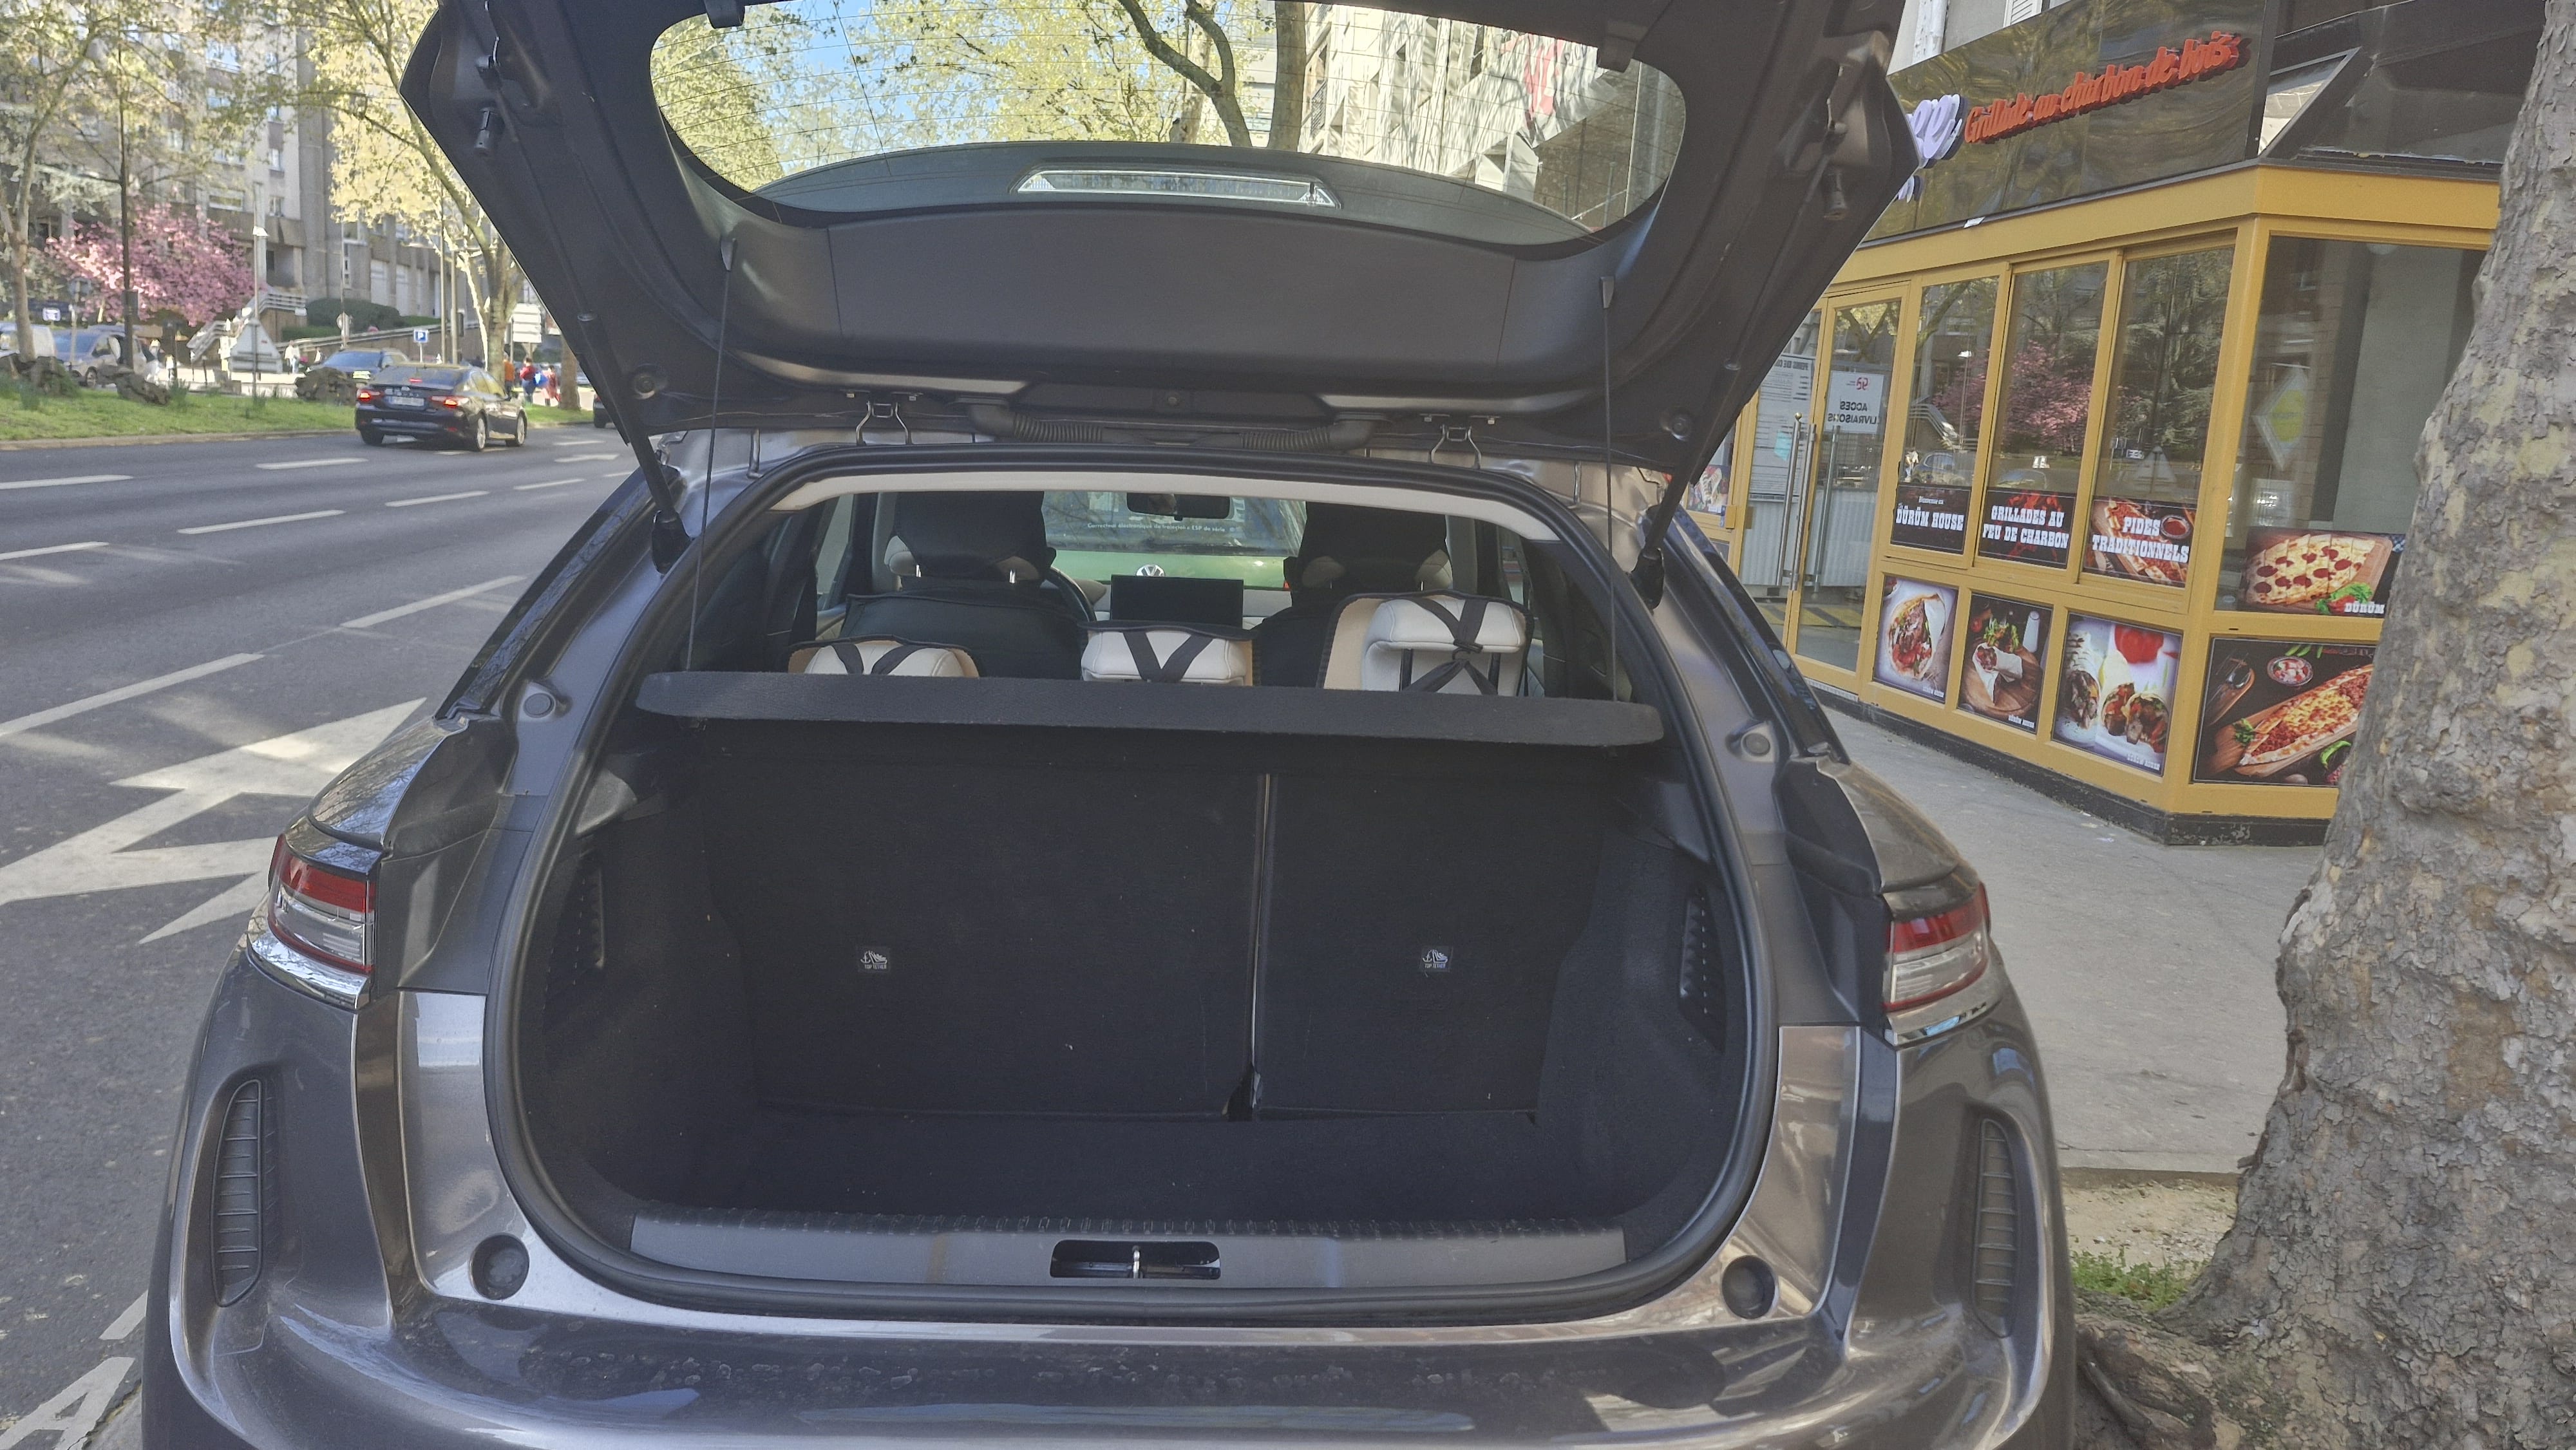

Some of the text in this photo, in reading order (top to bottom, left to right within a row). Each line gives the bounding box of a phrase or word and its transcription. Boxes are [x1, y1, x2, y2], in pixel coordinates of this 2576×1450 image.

[2034, 93, 2061, 121] au
[2061, 64, 2145, 113] charbon
[2145, 46, 2179, 88] de
[2179, 30, 2240, 79] bois
[1895, 505, 1964, 531] DÜRÜM HOUSE
[1991, 505, 2065, 527] GRILLADES AU
[2122, 516, 2161, 536] PIDES
[1982, 523, 2069, 549] FEU DE CHARBON
[2092, 534, 2190, 563] TRADITIONNELS
